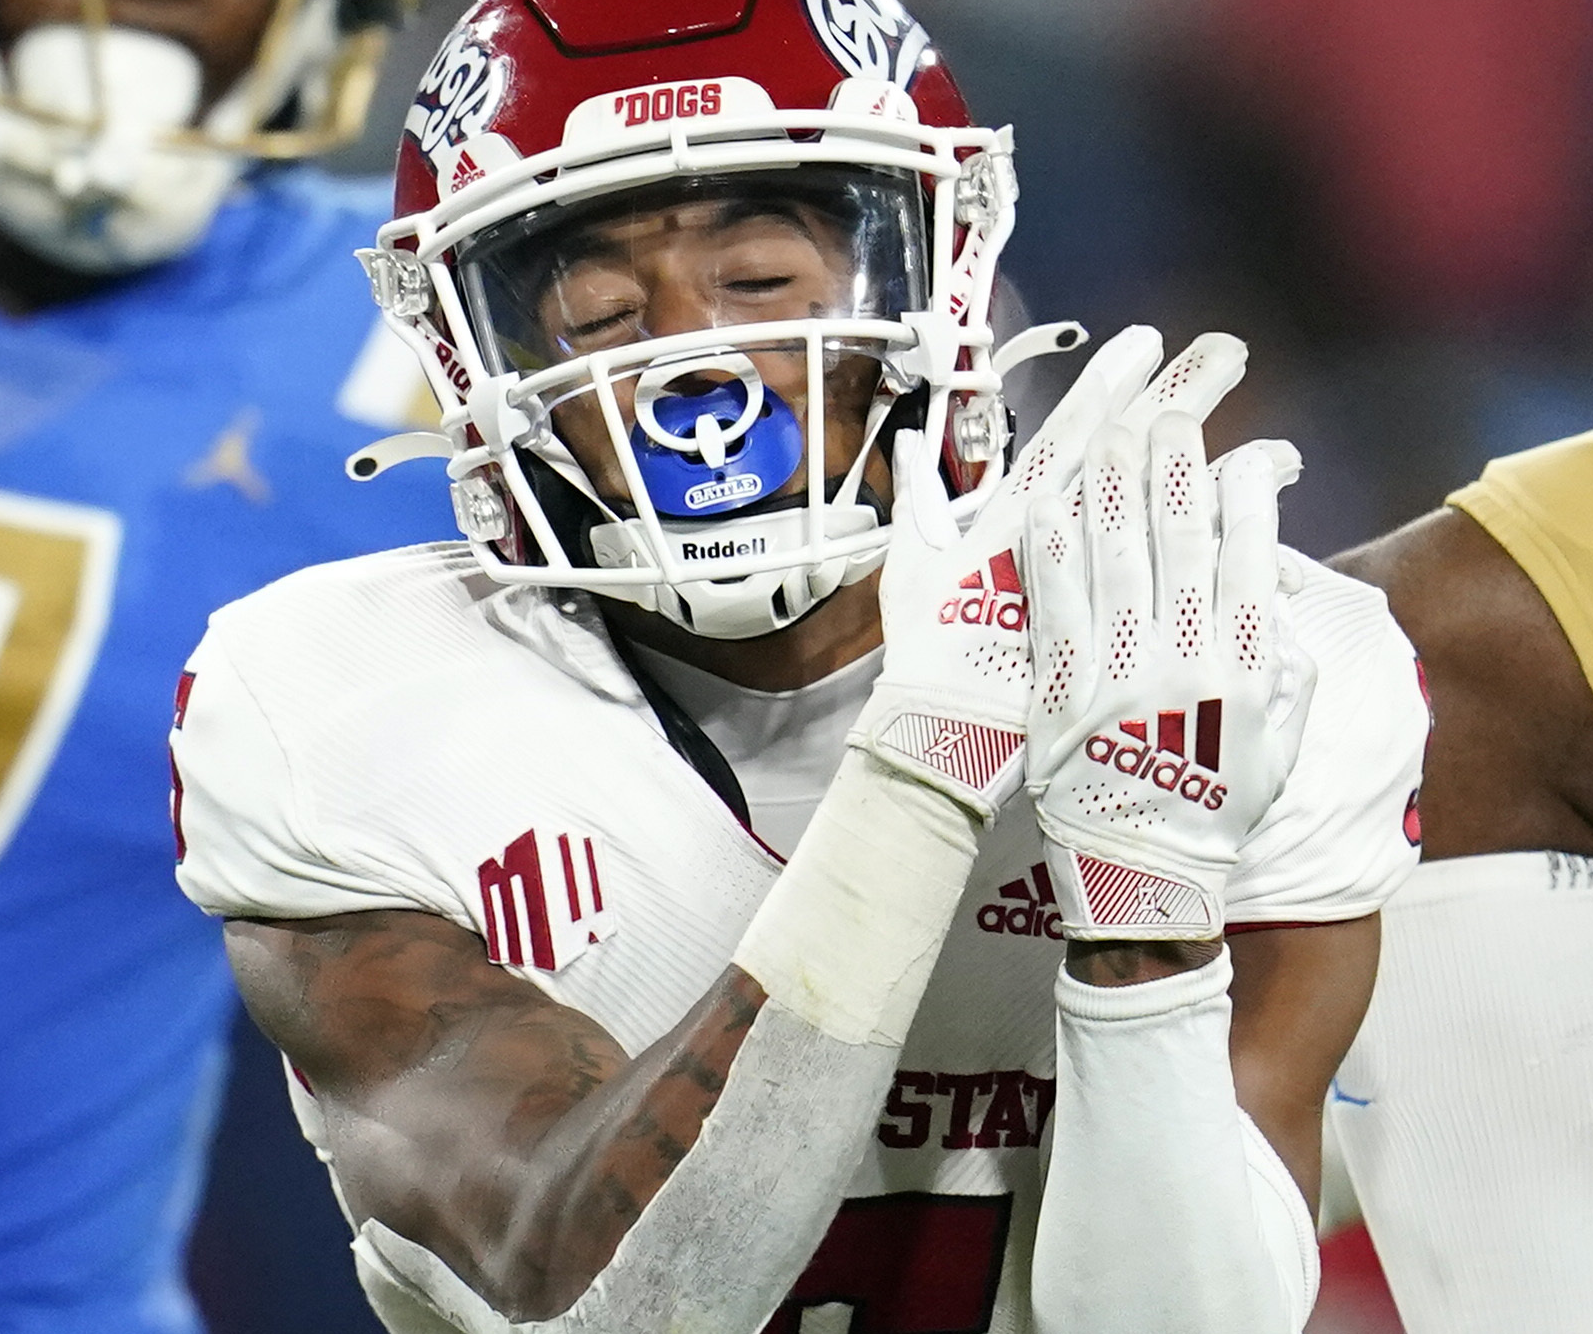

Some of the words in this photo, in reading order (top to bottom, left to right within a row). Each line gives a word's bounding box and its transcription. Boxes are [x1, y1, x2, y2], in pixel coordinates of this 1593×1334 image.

[614, 84, 721, 127] 'DOGS
[692, 478, 756, 505] BATTLE
[682, 538, 765, 560] Riddell
[938, 588, 1030, 632] adid
[1085, 734, 1228, 810] adidas
[878, 1070, 1057, 1149] STAT
